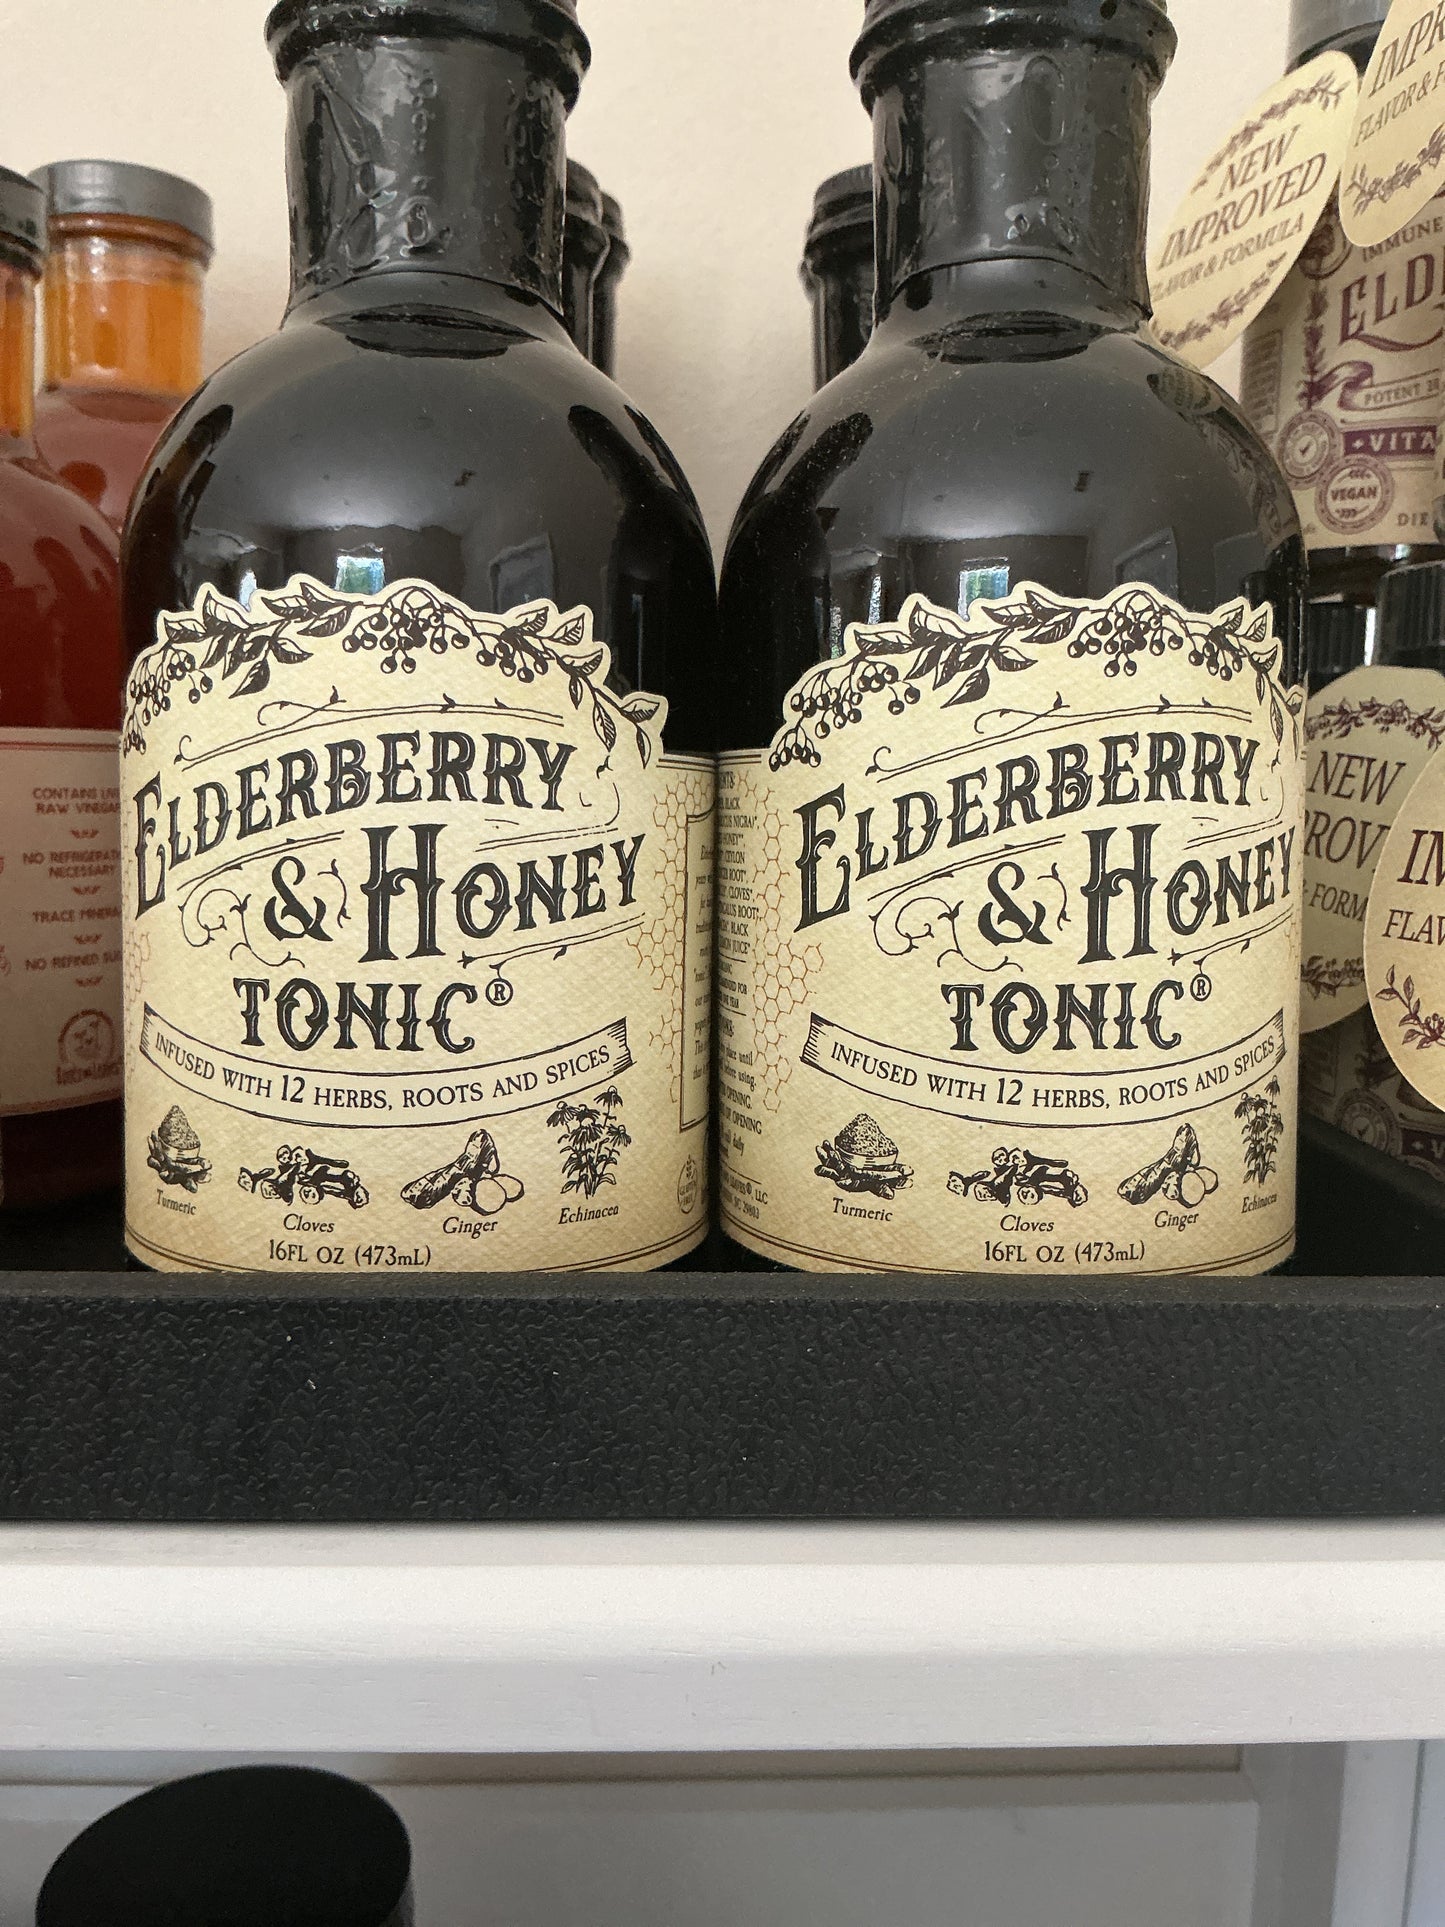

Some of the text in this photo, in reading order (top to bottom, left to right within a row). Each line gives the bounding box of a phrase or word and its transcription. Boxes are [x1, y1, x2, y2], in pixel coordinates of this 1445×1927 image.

[1215, 124, 1301, 200] NEW
[1157, 152, 1327, 270] IMPROVED
[1218, 212, 1304, 271] FORMULA
[1339, 246, 1445, 345] ELD
[1364, 382, 1420, 406] POTENT
[1331, 486, 1377, 501] VEGAN
[1306, 751, 1407, 806] NEW
[36, 802, 69, 814] RAW
[133, 730, 577, 920] ELDERBERRY
[793, 732, 1260, 932] ELDERBERRY
[1304, 809, 1391, 873] ROV
[22, 851, 44, 865] NO
[48, 864, 114, 878] NECESSARY
[264, 824, 645, 962] & HONEY
[978, 824, 1295, 964] & HONEY
[32, 909, 75, 923] TRACE
[25, 957, 47, 971] NO
[155, 1032, 215, 1080] INFUSED
[222, 1067, 272, 1098] WITH
[282, 1074, 305, 1104] 12
[314, 1087, 393, 1110] HERBS,
[403, 1082, 484, 1108] ROOTS
[493, 1072, 538, 1098] AND
[546, 1045, 610, 1084] SPICES
[738, 1050, 753, 1067] until
[831, 1035, 1275, 1109] INFUSED WITH 12 HERBS, ROOTS AND SPICES
[732, 1109, 762, 1135] OPENING
[157, 1189, 197, 1216] Turmeric
[558, 1205, 619, 1225] Echinacea
[832, 1197, 893, 1222] Turmeric
[1241, 1193, 1278, 1214] Echinacea
[283, 1214, 334, 1233] Cloves
[443, 1217, 498, 1239] Ginger
[1000, 1214, 1054, 1232] Cloves
[1155, 1210, 1199, 1231] Ginger
[269, 1239, 431, 1267] 16FL OZ (473mL)
[985, 1240, 1145, 1264] 16FL OZ (473mL)
